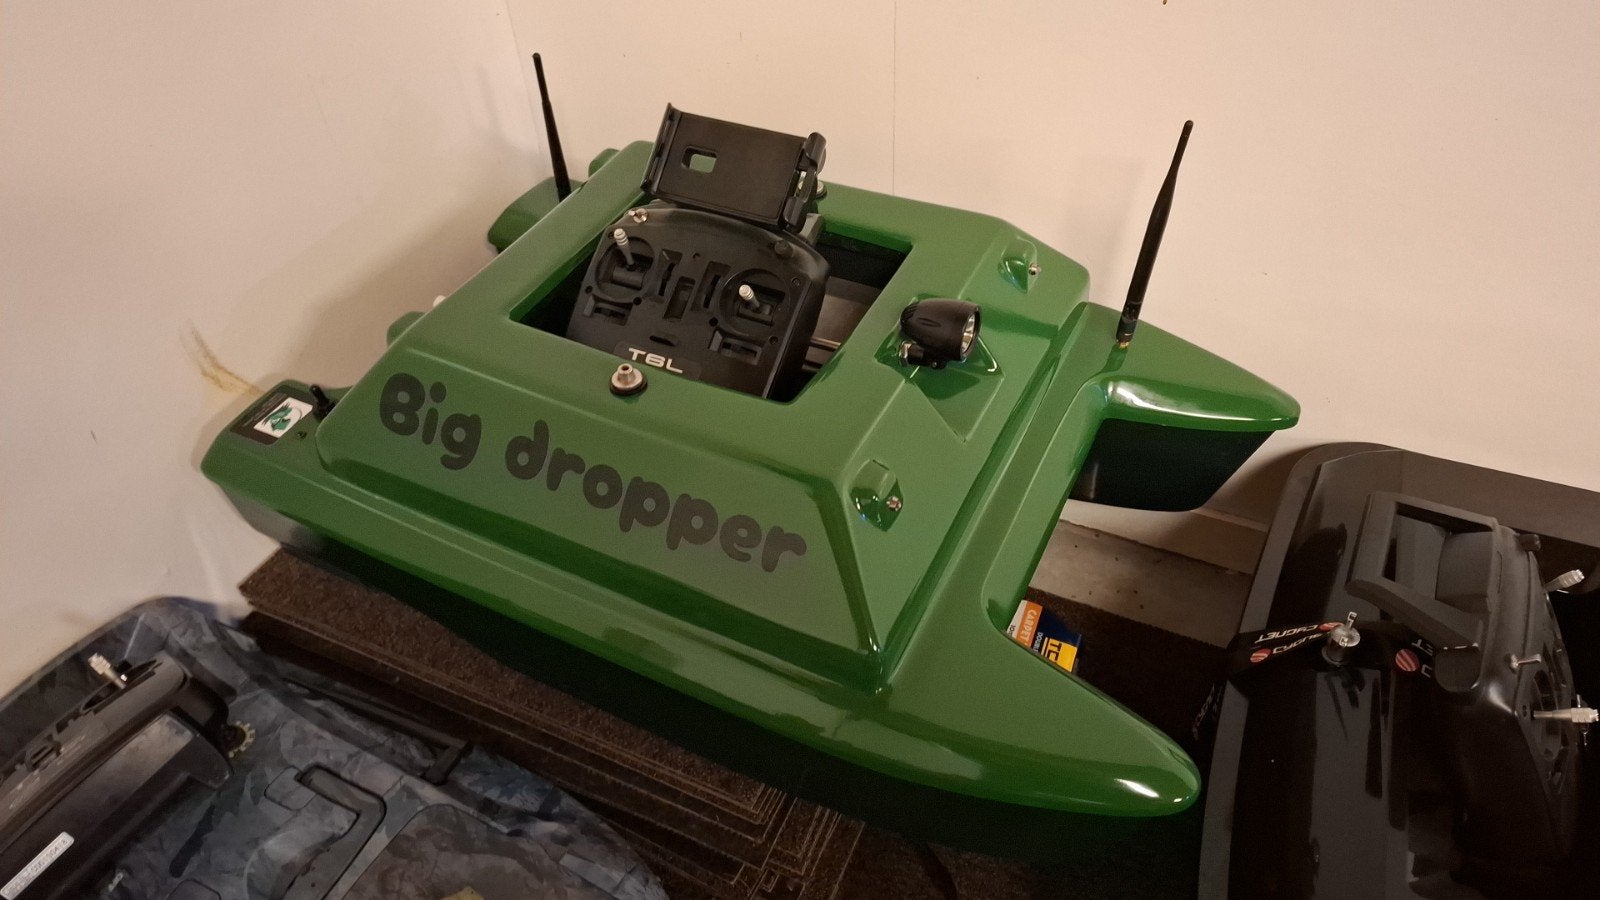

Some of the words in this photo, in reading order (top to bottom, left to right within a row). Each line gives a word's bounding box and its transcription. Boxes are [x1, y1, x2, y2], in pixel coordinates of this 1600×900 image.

[628, 347, 683, 374] T6L
[380, 372, 482, 470] Big
[505, 420, 807, 572] dropper
